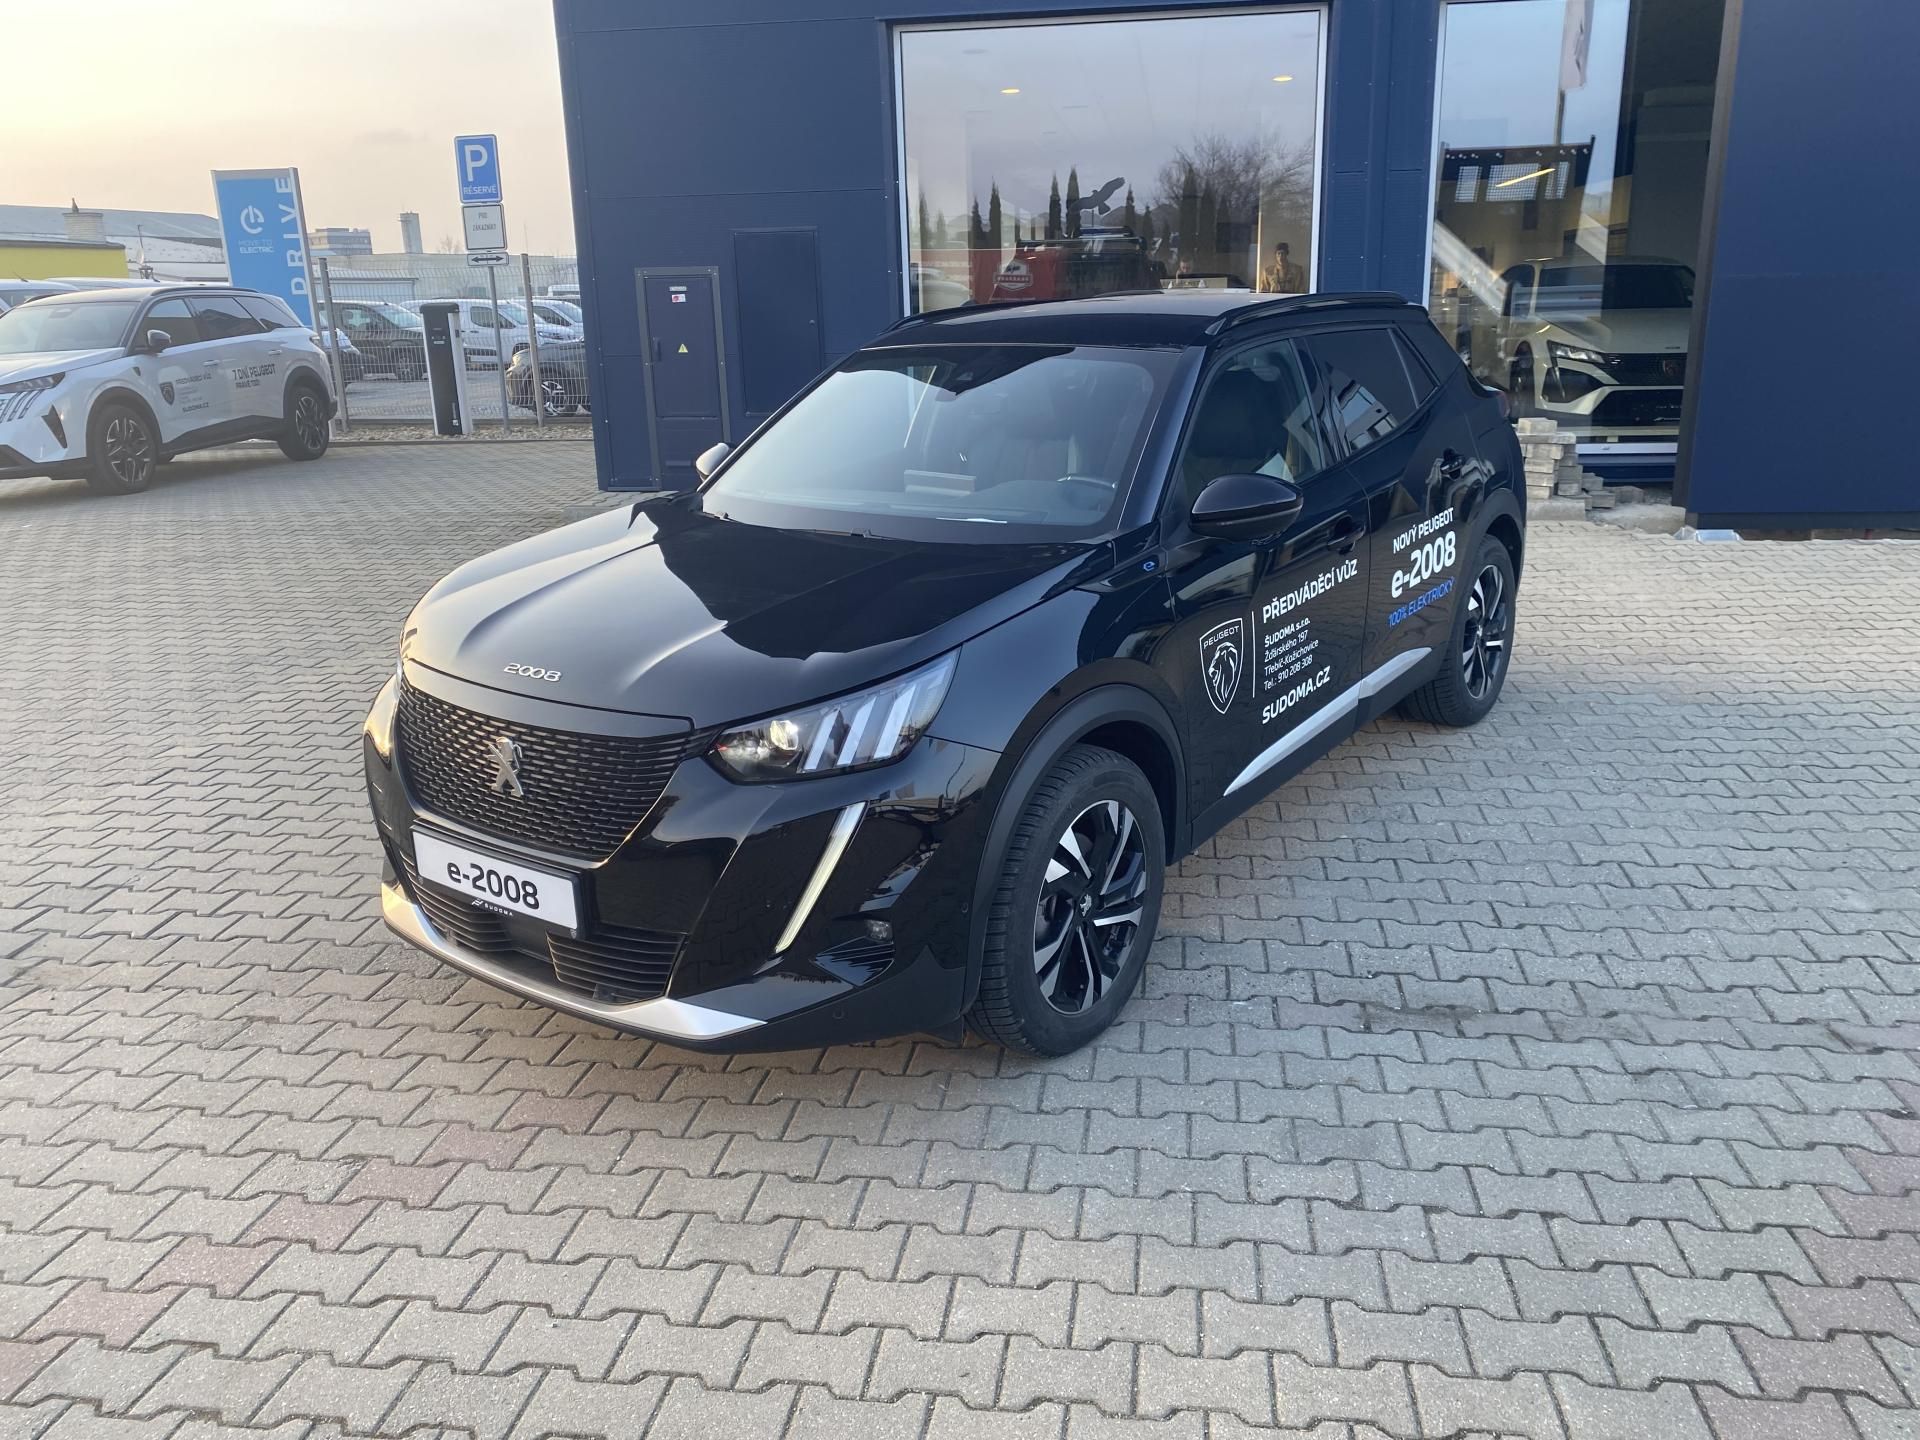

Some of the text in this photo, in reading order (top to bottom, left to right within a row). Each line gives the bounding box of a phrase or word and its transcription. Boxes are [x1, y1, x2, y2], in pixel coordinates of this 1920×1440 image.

[464, 144, 488, 182] P
[239, 246, 275, 254] ELECTRIC
[275, 177, 308, 295] DRIVE
[250, 363, 276, 378] PEUGEOT
[1393, 507, 1454, 554] NOVÝ PEUGEOT
[1391, 530, 1456, 599] e-2008
[1262, 558, 1358, 624] PŘEDVÁDĚCÍ VŮZ
[1388, 576, 1455, 628] 100% ELEKTRICKÝ
[1203, 625, 1240, 650] PEUGEOT
[1264, 617, 1311, 648] ŠUDOMA s.r.o.
[1297, 630, 1309, 644] 197
[503, 662, 561, 682] 2008
[1264, 675, 1277, 691] Tel.:
[1277, 669, 1289, 684] 910
[1289, 662, 1301, 677] 208
[1262, 665, 1331, 725] SUDOMA.CZ
[446, 861, 540, 910] e-2008
